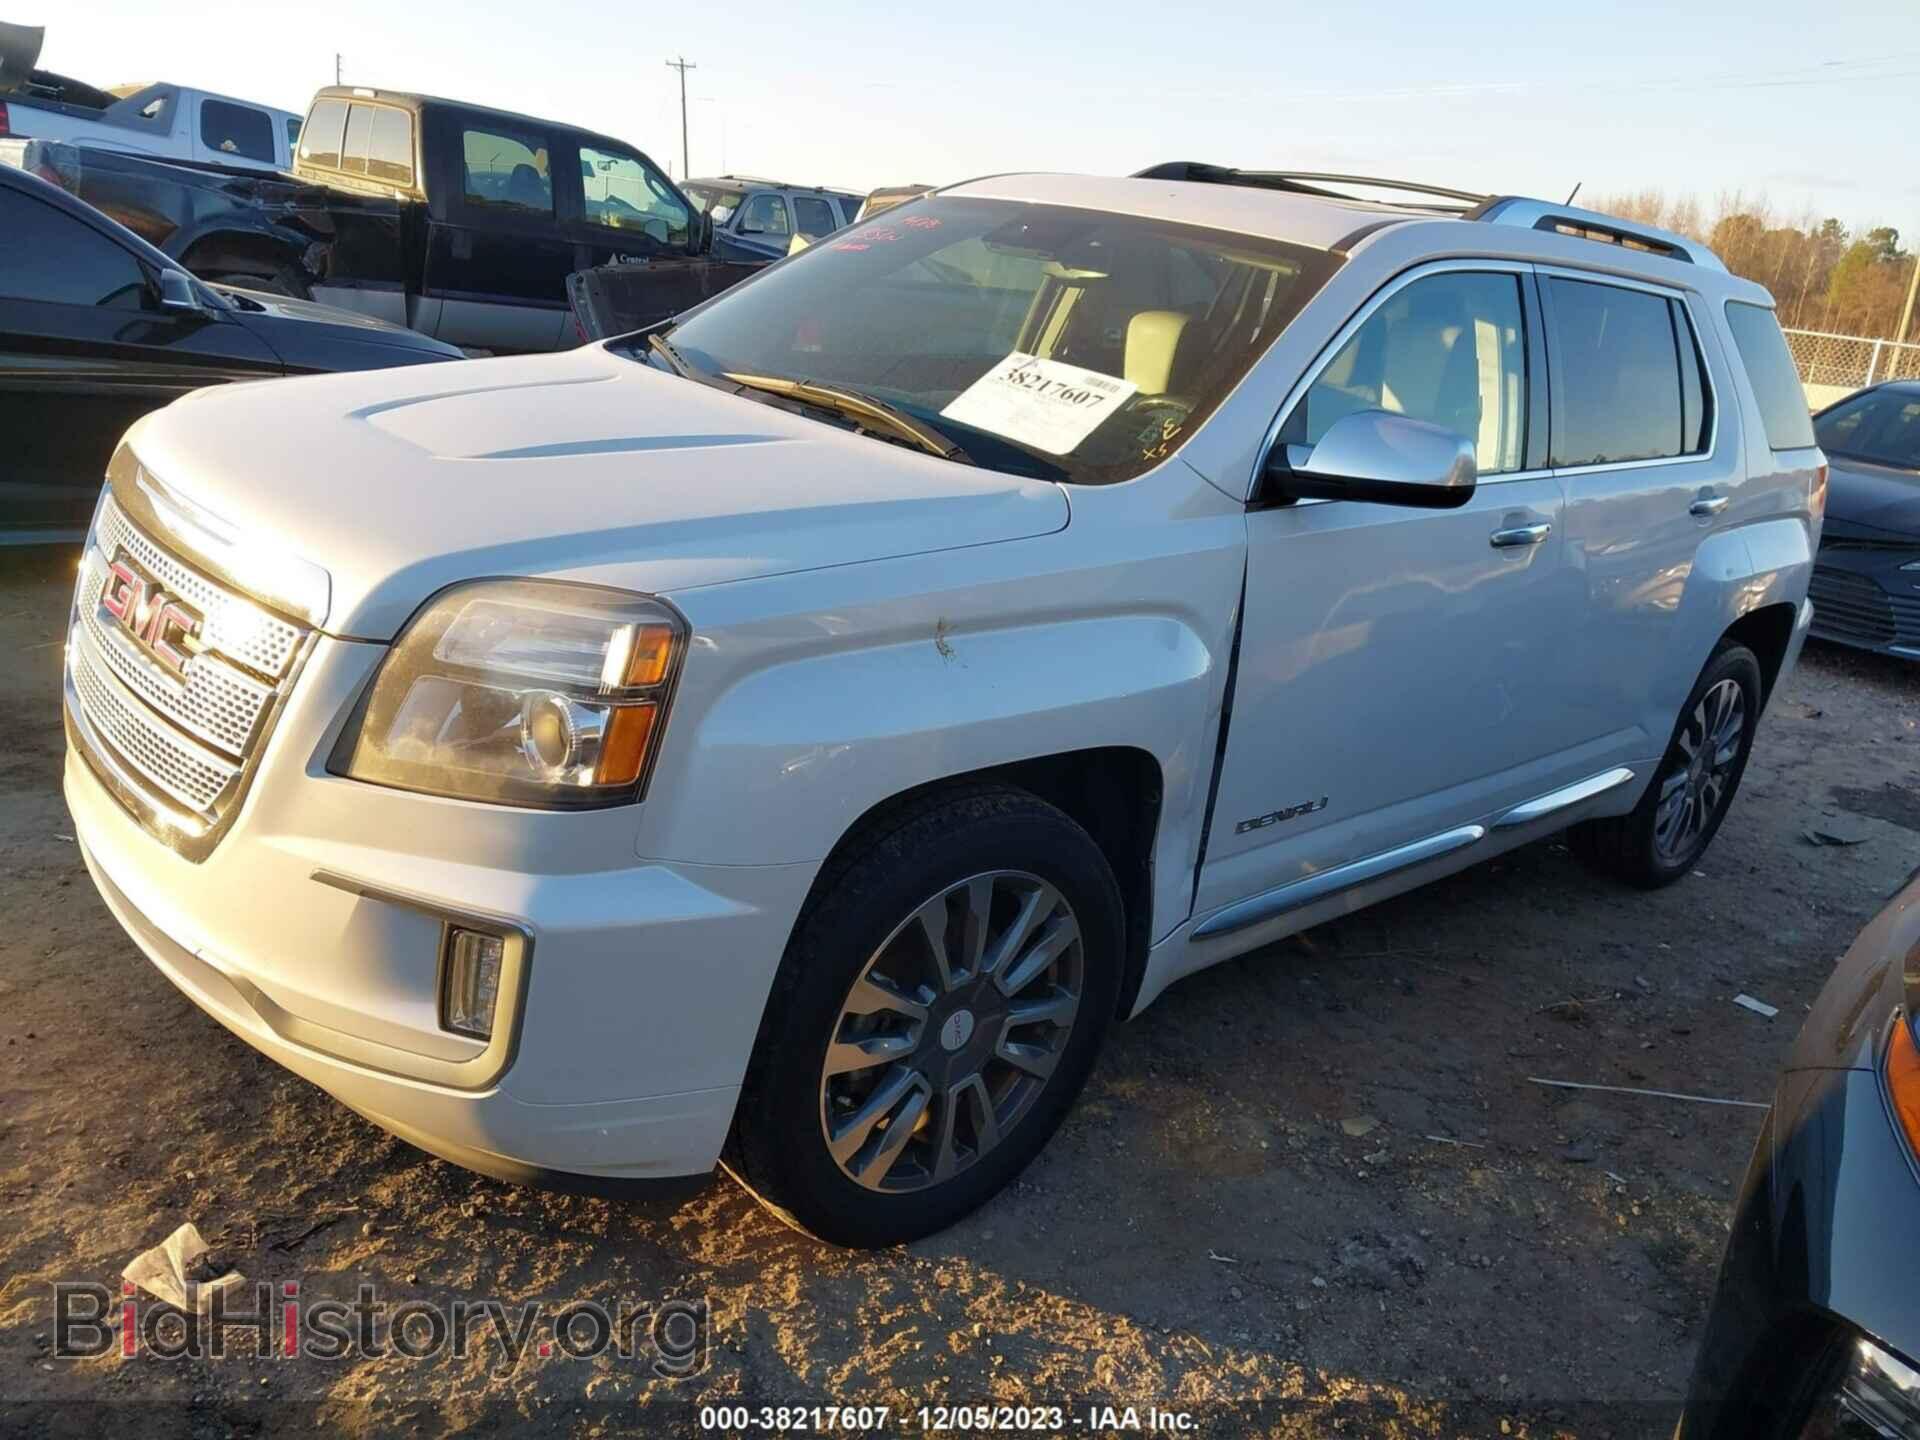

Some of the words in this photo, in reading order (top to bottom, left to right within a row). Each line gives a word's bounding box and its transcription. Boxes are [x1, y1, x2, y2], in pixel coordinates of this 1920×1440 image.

[999, 367, 1106, 410] 38217607
[102, 560, 200, 674] GMC
[1234, 796, 1329, 834] DENALI
